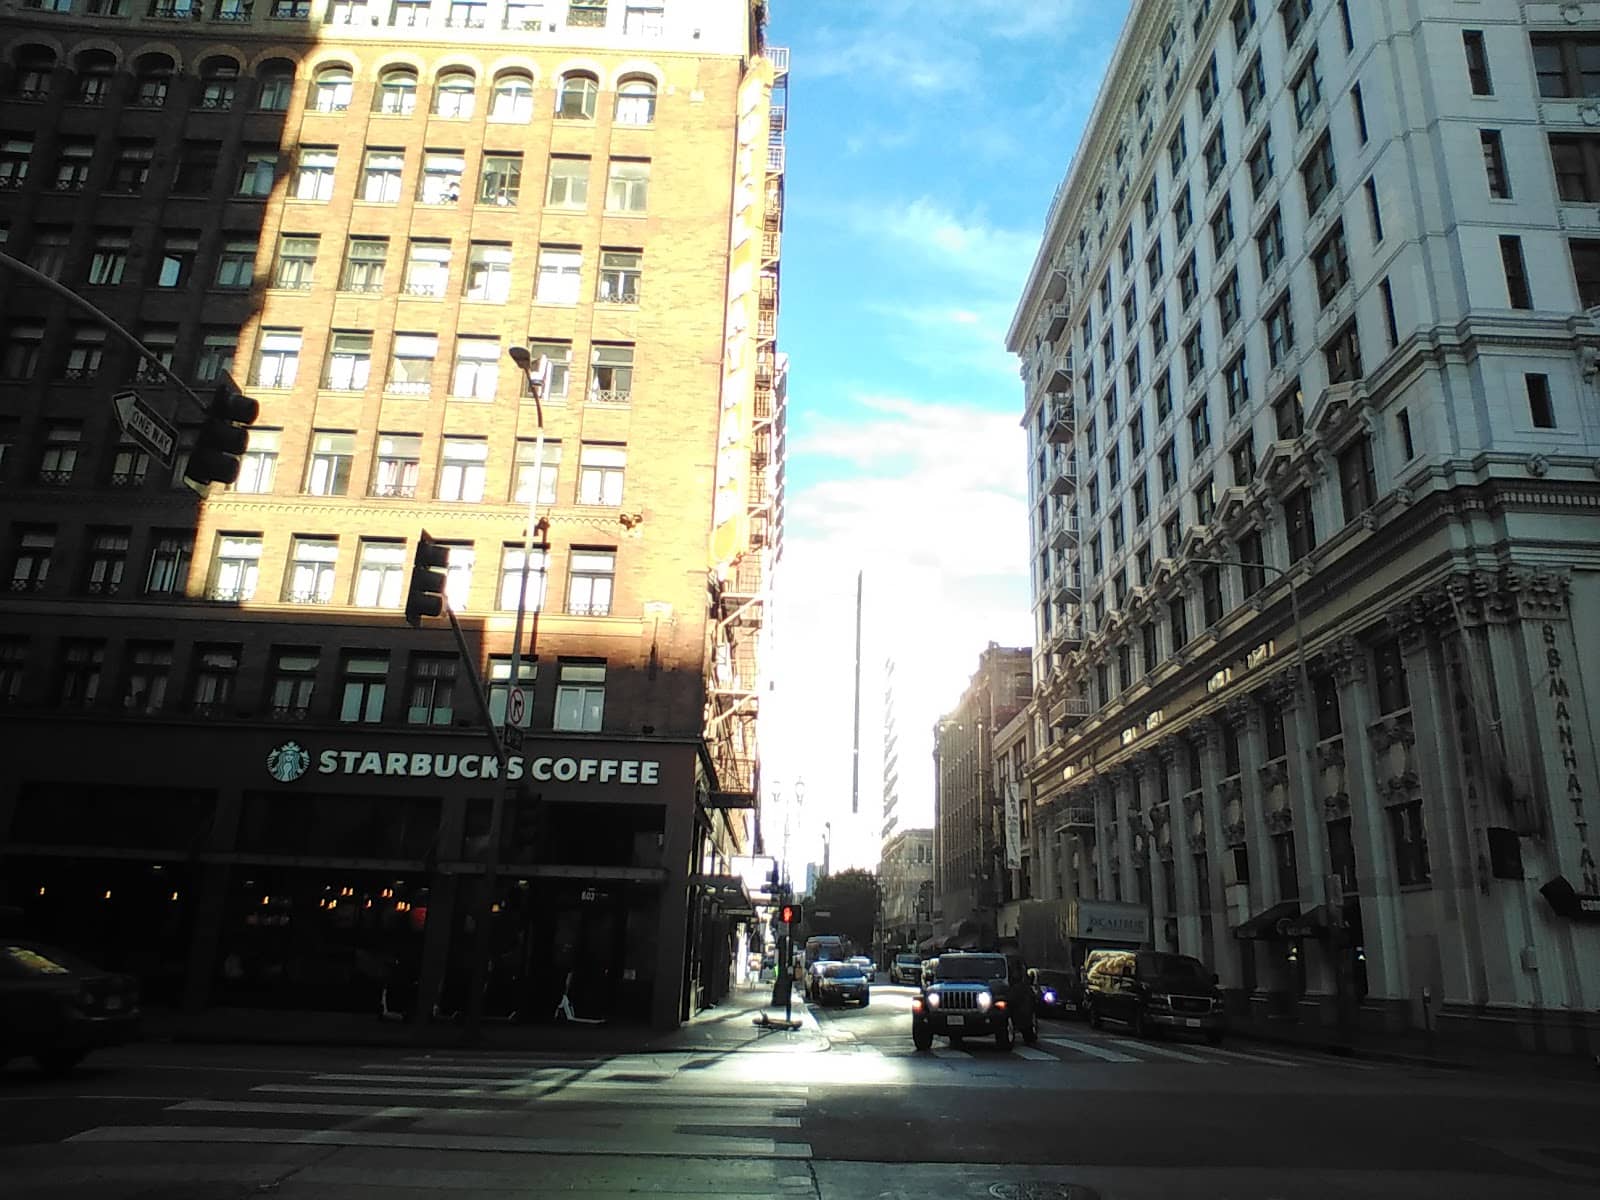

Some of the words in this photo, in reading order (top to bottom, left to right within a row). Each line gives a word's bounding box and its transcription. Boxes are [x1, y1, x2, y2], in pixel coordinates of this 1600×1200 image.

[133, 411, 151, 436] ONE
[150, 425, 171, 451] WAY
[318, 749, 525, 781] STARBUCKS
[531, 757, 660, 785] COFFEE
